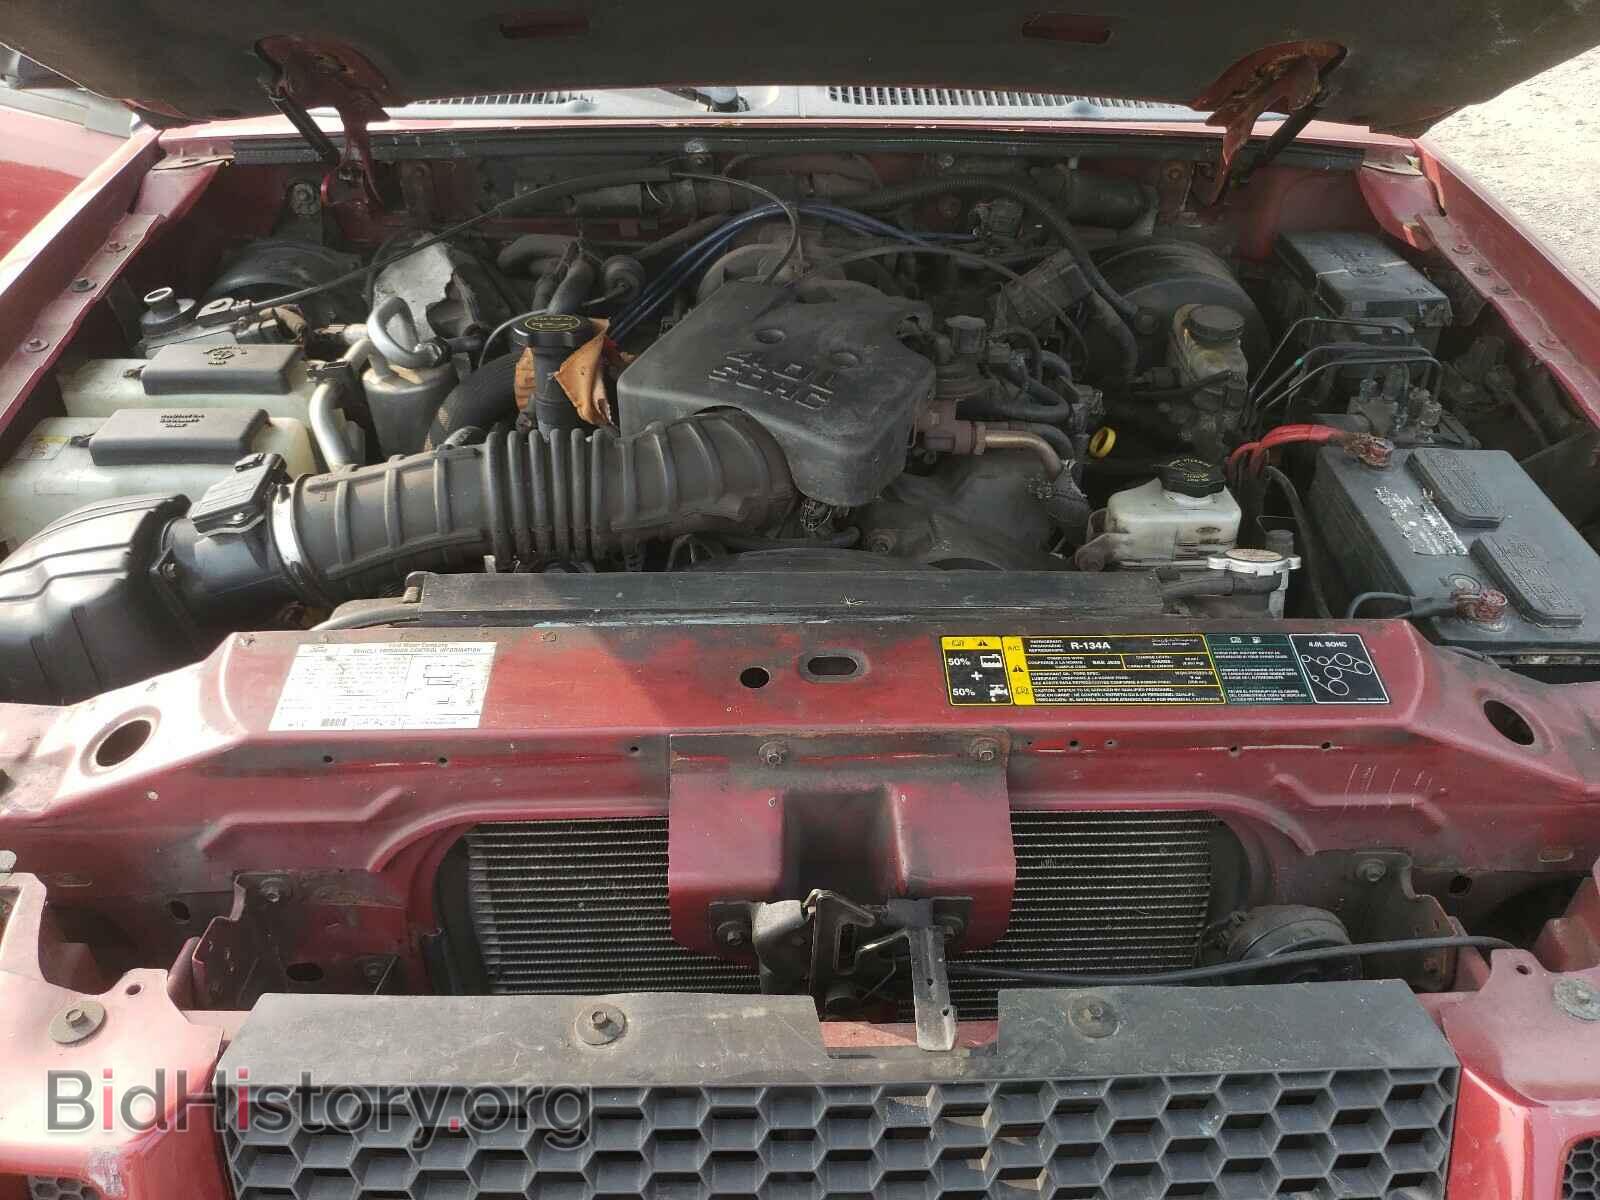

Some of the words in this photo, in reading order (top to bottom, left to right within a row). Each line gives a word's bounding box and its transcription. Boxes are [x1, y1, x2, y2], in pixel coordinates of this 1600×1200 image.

[1070, 641, 1112, 650] R-134A
[947, 657, 971, 667] 50%
[952, 688, 976, 697] 50%
